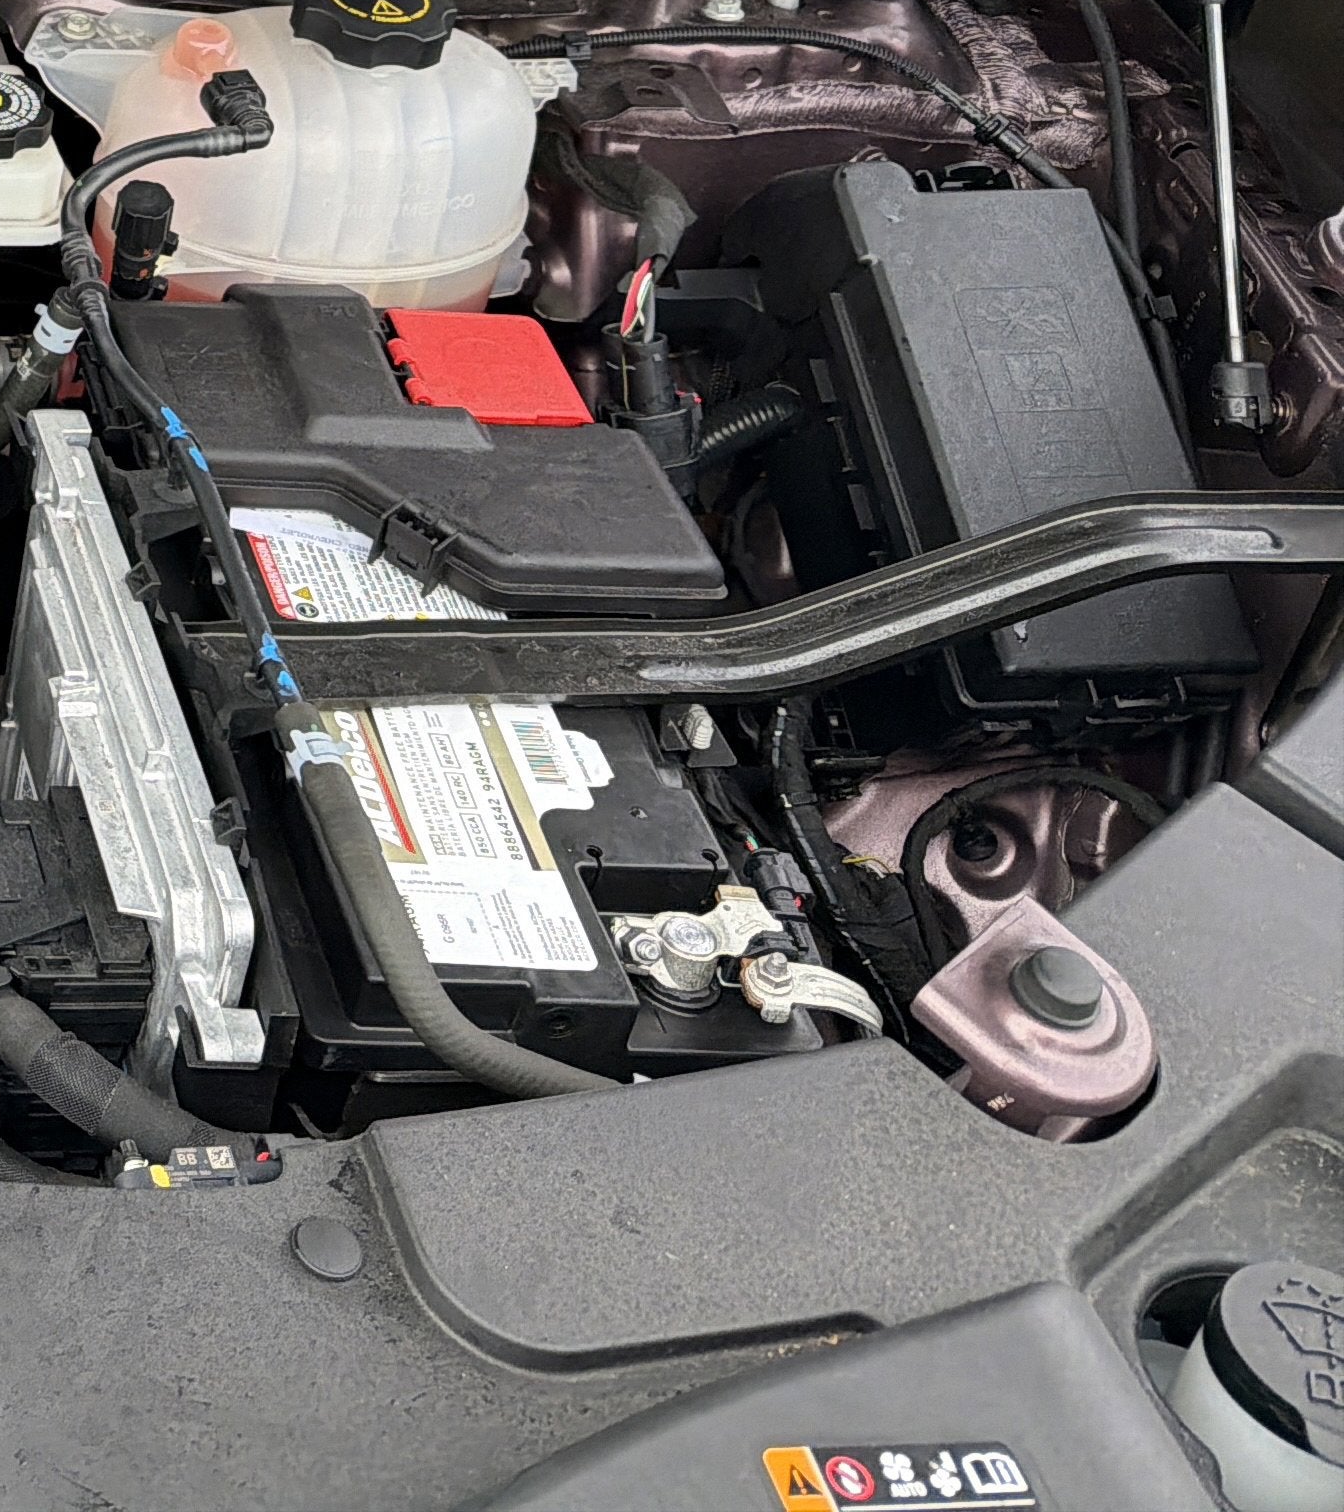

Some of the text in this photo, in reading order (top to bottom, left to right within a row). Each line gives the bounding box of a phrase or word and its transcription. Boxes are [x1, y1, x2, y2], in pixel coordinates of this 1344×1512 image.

[280, 528, 342, 545] CHEVROLET
[394, 741, 410, 762] FREE
[407, 722, 437, 782] MANTENIMIENTO
[464, 741, 495, 790] 94RAGM
[334, 711, 402, 847] ACDelco
[402, 732, 456, 855] BATTERIE SANS ENTRETIEN AGM
[431, 785, 442, 795] DE
[450, 775, 469, 804] 140 RC
[405, 766, 436, 830] MAINTENANCE
[436, 799, 452, 820] LIBRE
[444, 823, 466, 856] BATERÍA
[466, 816, 489, 853] 850 CCA
[487, 798, 523, 860] 88864542
[429, 834, 446, 854] AGM
[443, 935, 456, 943] G
[176, 1153, 198, 1165] BB
[891, 1481, 927, 1497] AUTO
